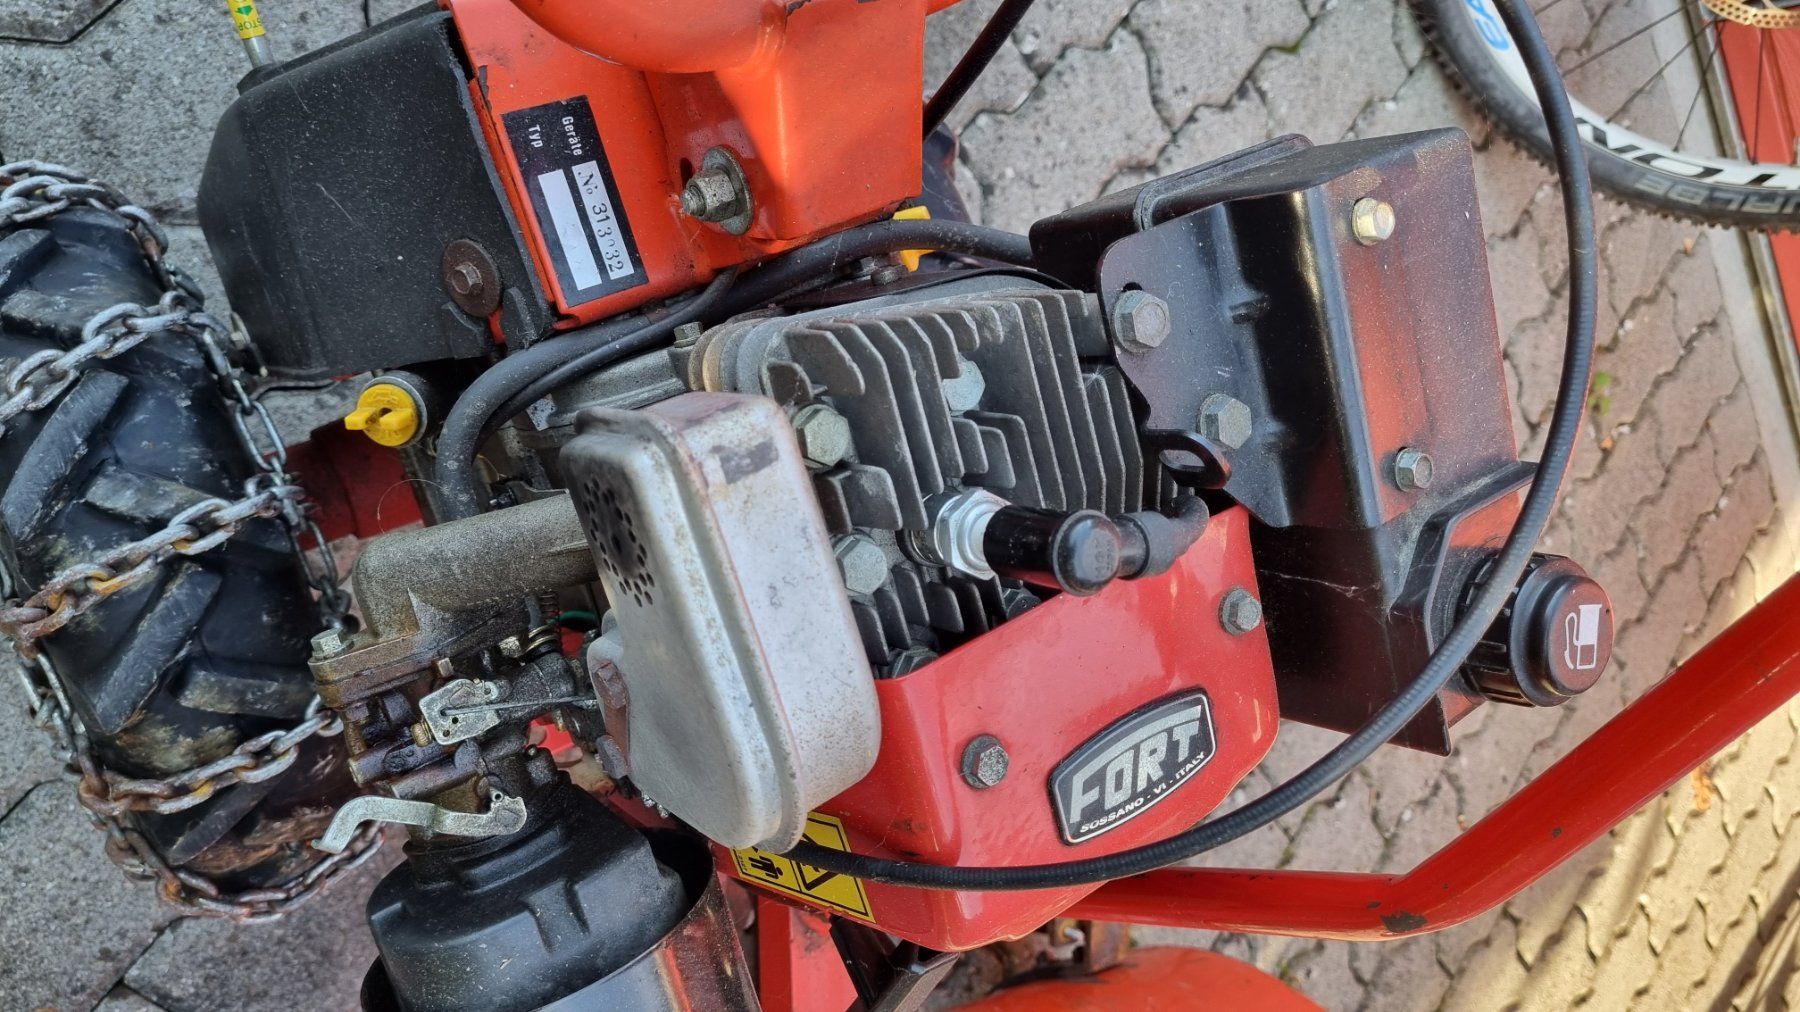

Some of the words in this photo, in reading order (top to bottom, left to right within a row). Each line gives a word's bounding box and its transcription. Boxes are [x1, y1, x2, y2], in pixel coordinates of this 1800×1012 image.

[528, 124, 543, 148] Typ
[561, 116, 583, 156] Geräte
[1633, 171, 1800, 215] ALBE
[1069, 704, 1202, 824] FORT
[1080, 797, 1144, 833] SOSSANO
[1153, 782, 1167, 795] VI
[1175, 751, 1205, 779] ITALY
